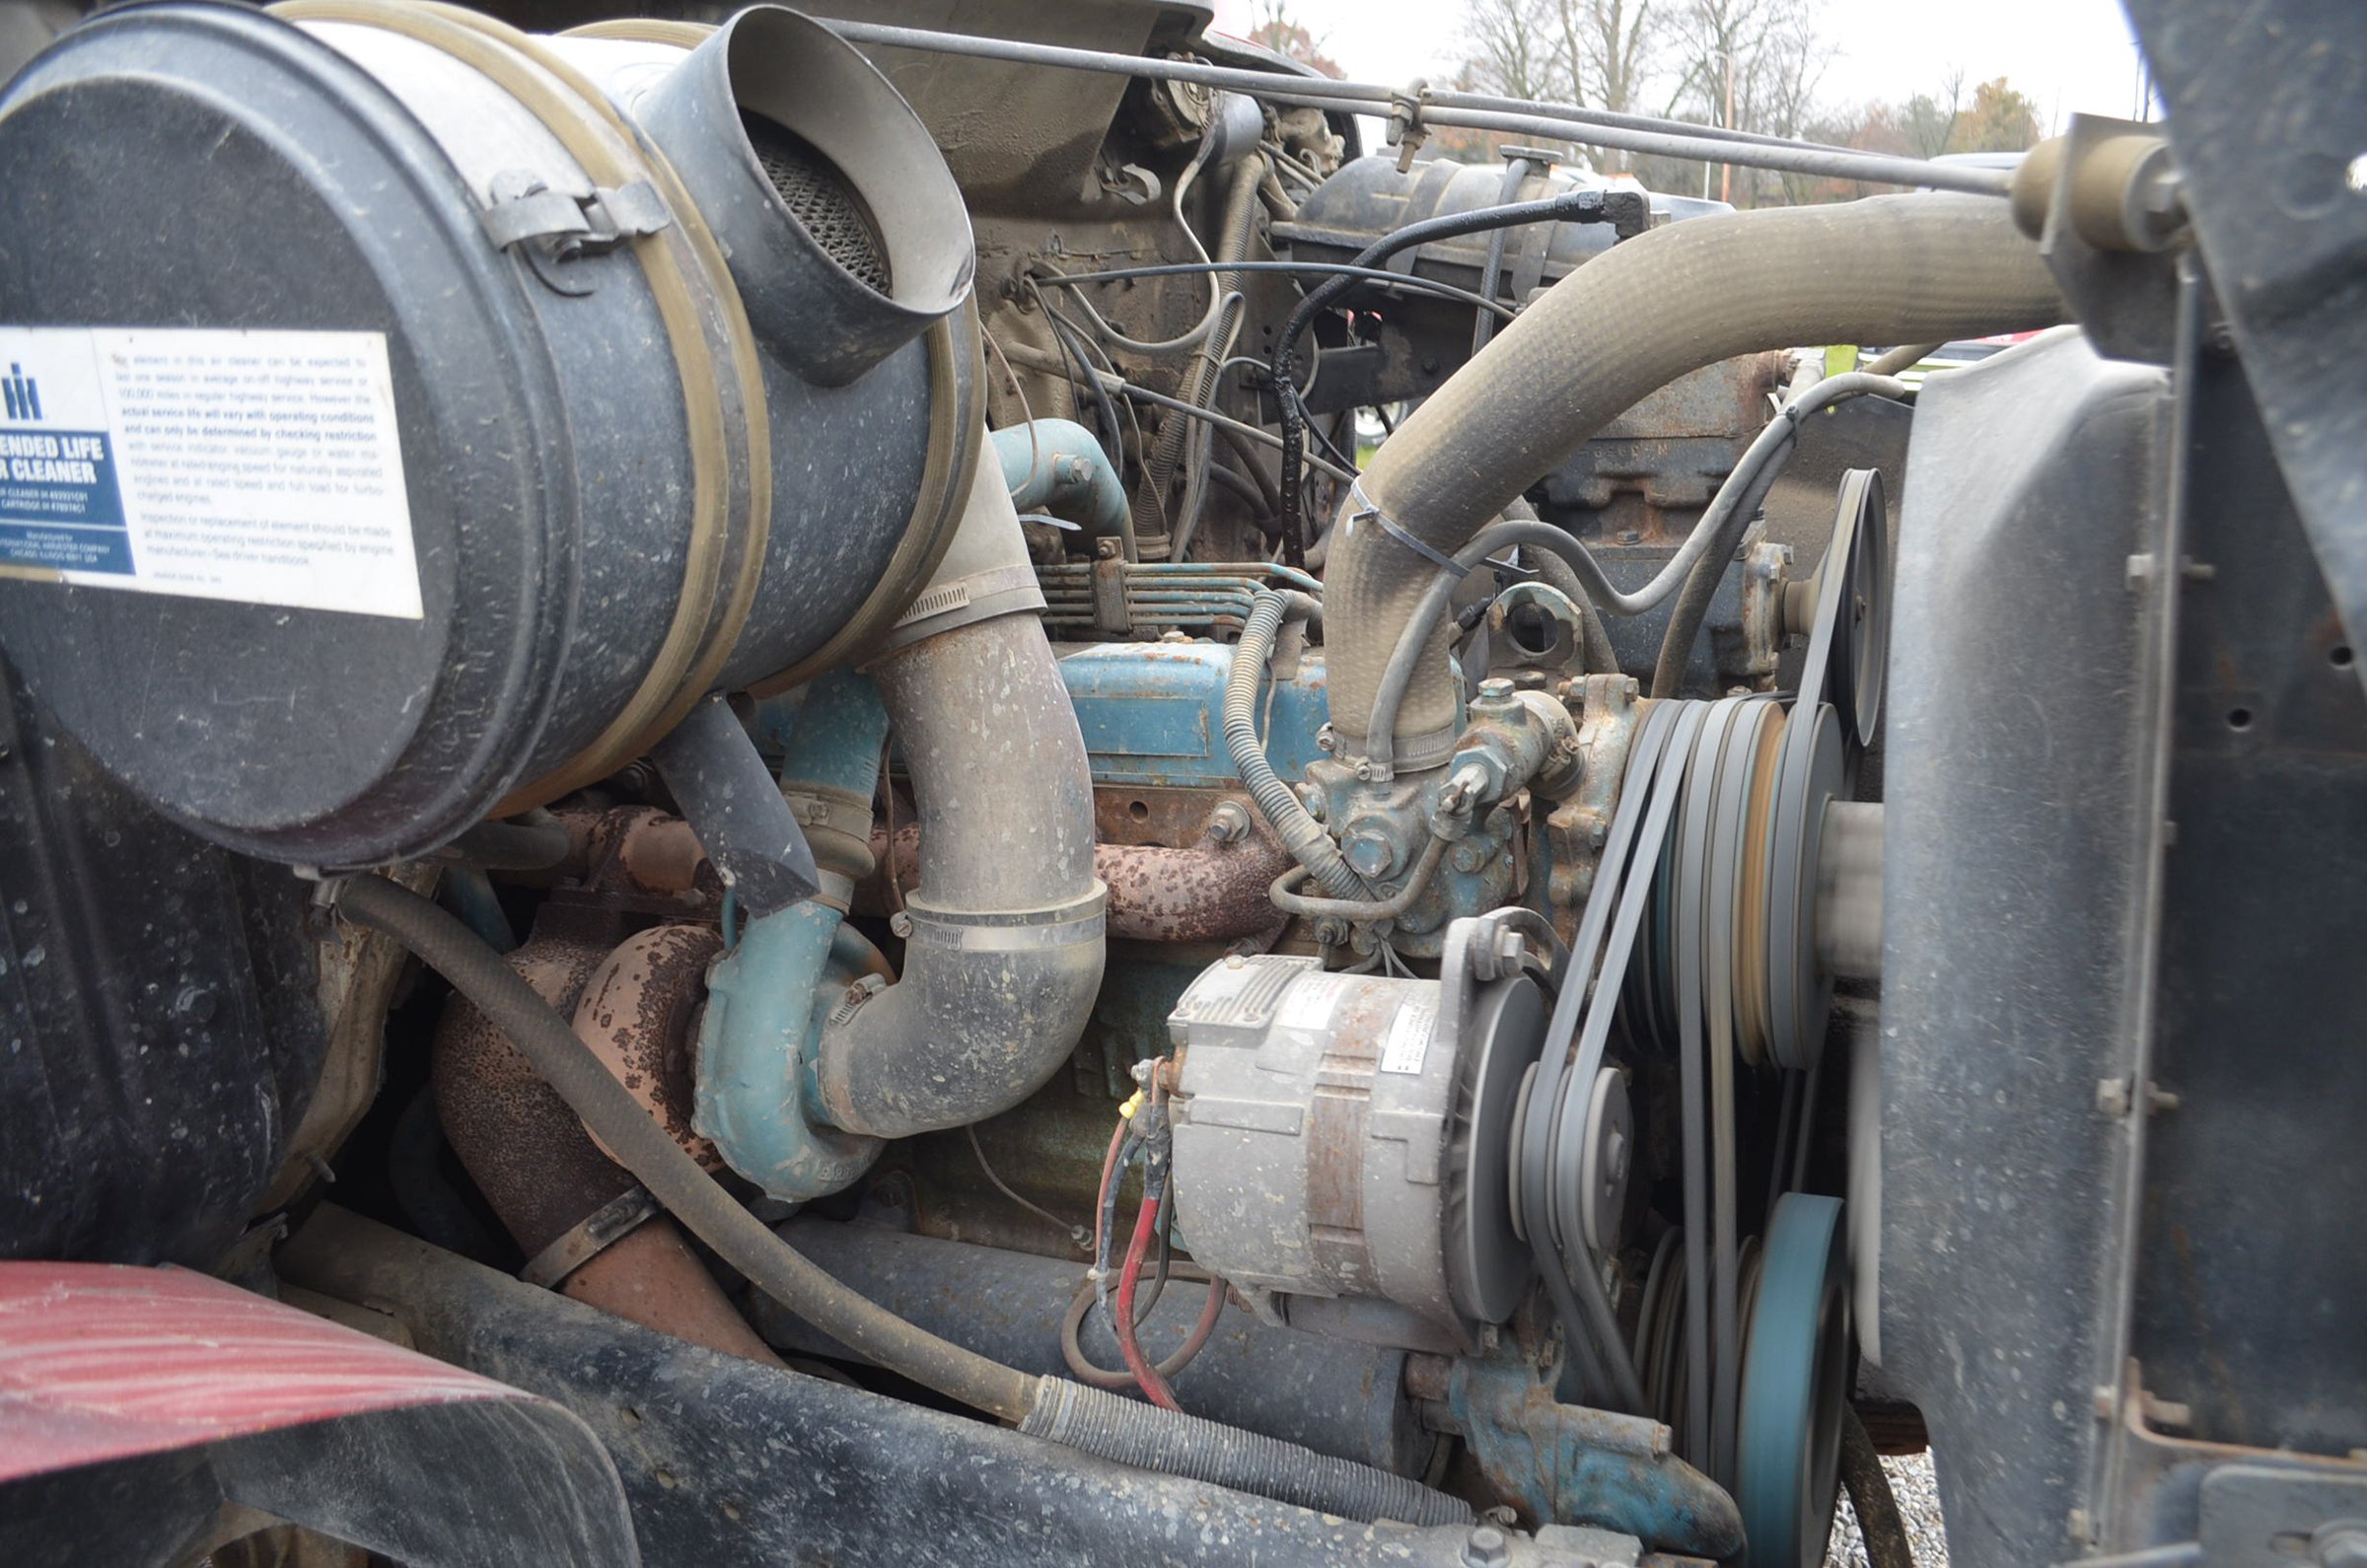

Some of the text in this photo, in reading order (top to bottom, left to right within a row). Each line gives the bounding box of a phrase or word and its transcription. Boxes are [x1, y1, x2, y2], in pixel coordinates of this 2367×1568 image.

[308, 357, 350, 369] expected
[275, 376, 315, 387] highway
[320, 376, 353, 386] service
[122, 407, 150, 418] actual
[152, 408, 184, 418] service
[205, 409, 221, 419] will
[223, 411, 243, 422] vary
[247, 410, 266, 420] with
[268, 410, 318, 424] operating
[321, 411, 375, 423] conditions
[124, 424, 377, 442] and can only be determined by checking restriction
[61, 437, 104, 461] LIFE
[12, 459, 97, 484] CLEANER
